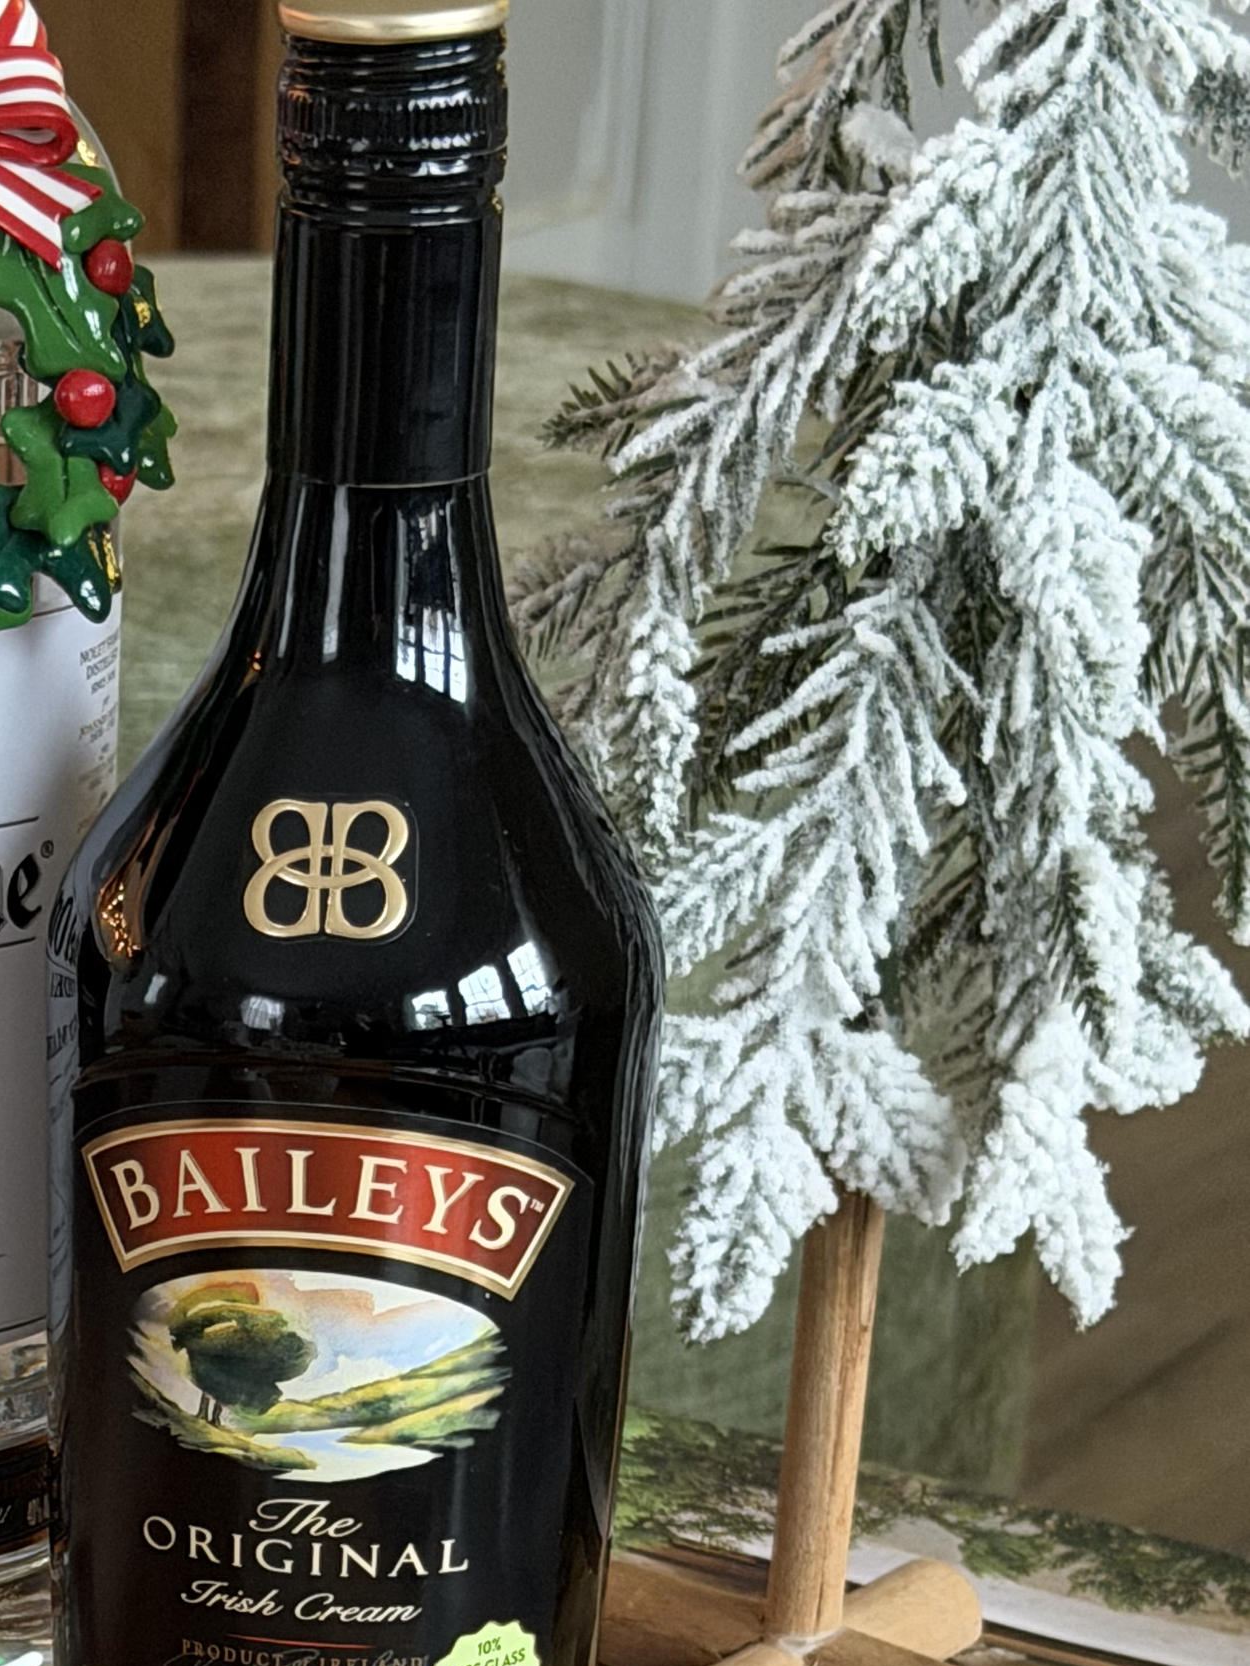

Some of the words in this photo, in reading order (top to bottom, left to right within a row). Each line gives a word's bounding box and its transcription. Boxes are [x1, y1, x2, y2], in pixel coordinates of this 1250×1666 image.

[248, 1497, 363, 1538] The
[143, 1515, 469, 1579] ORIGINAL
[180, 1578, 283, 1618] Irish
[293, 1591, 424, 1624] Cream
[477, 1637, 501, 1656] 10%
